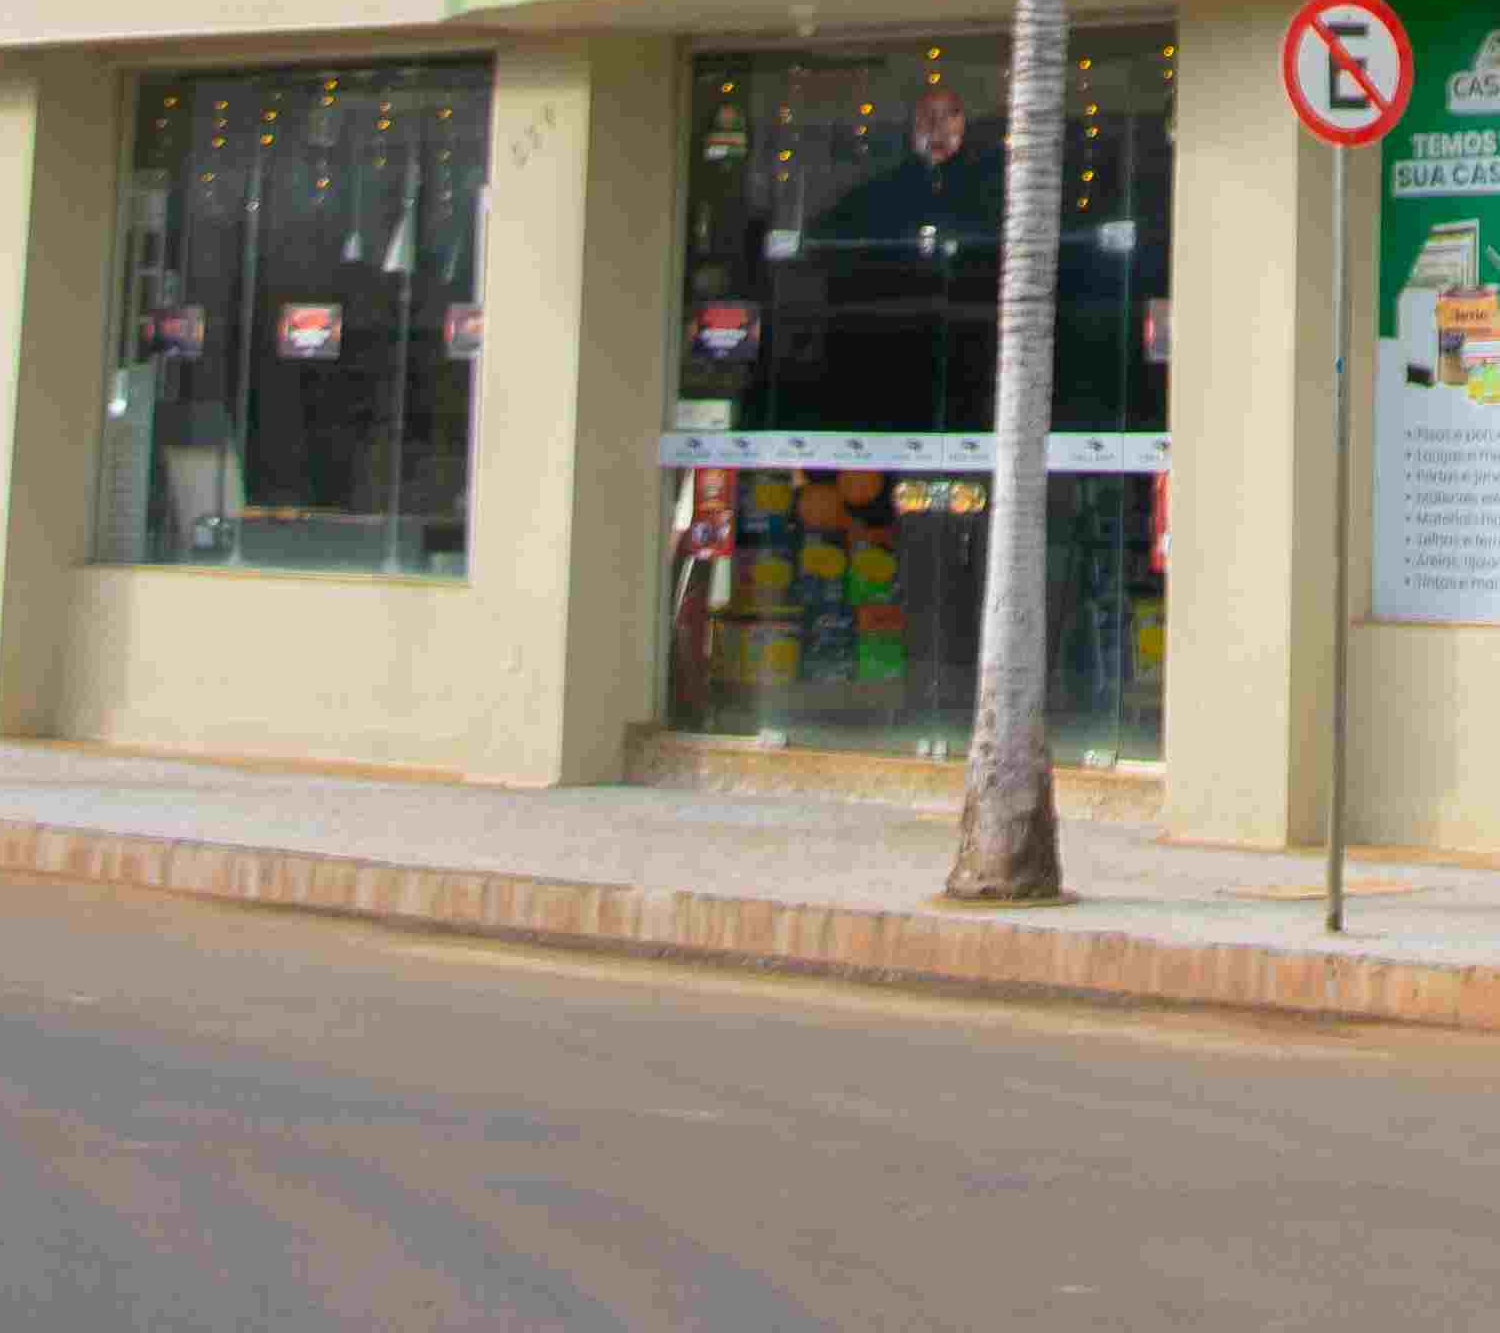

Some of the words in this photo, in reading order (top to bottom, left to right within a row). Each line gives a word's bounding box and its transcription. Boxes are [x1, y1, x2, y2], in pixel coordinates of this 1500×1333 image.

[1325, 21, 1368, 109] E
[1411, 130, 1497, 158] TEMOS
[1397, 165, 1446, 188] SUA
